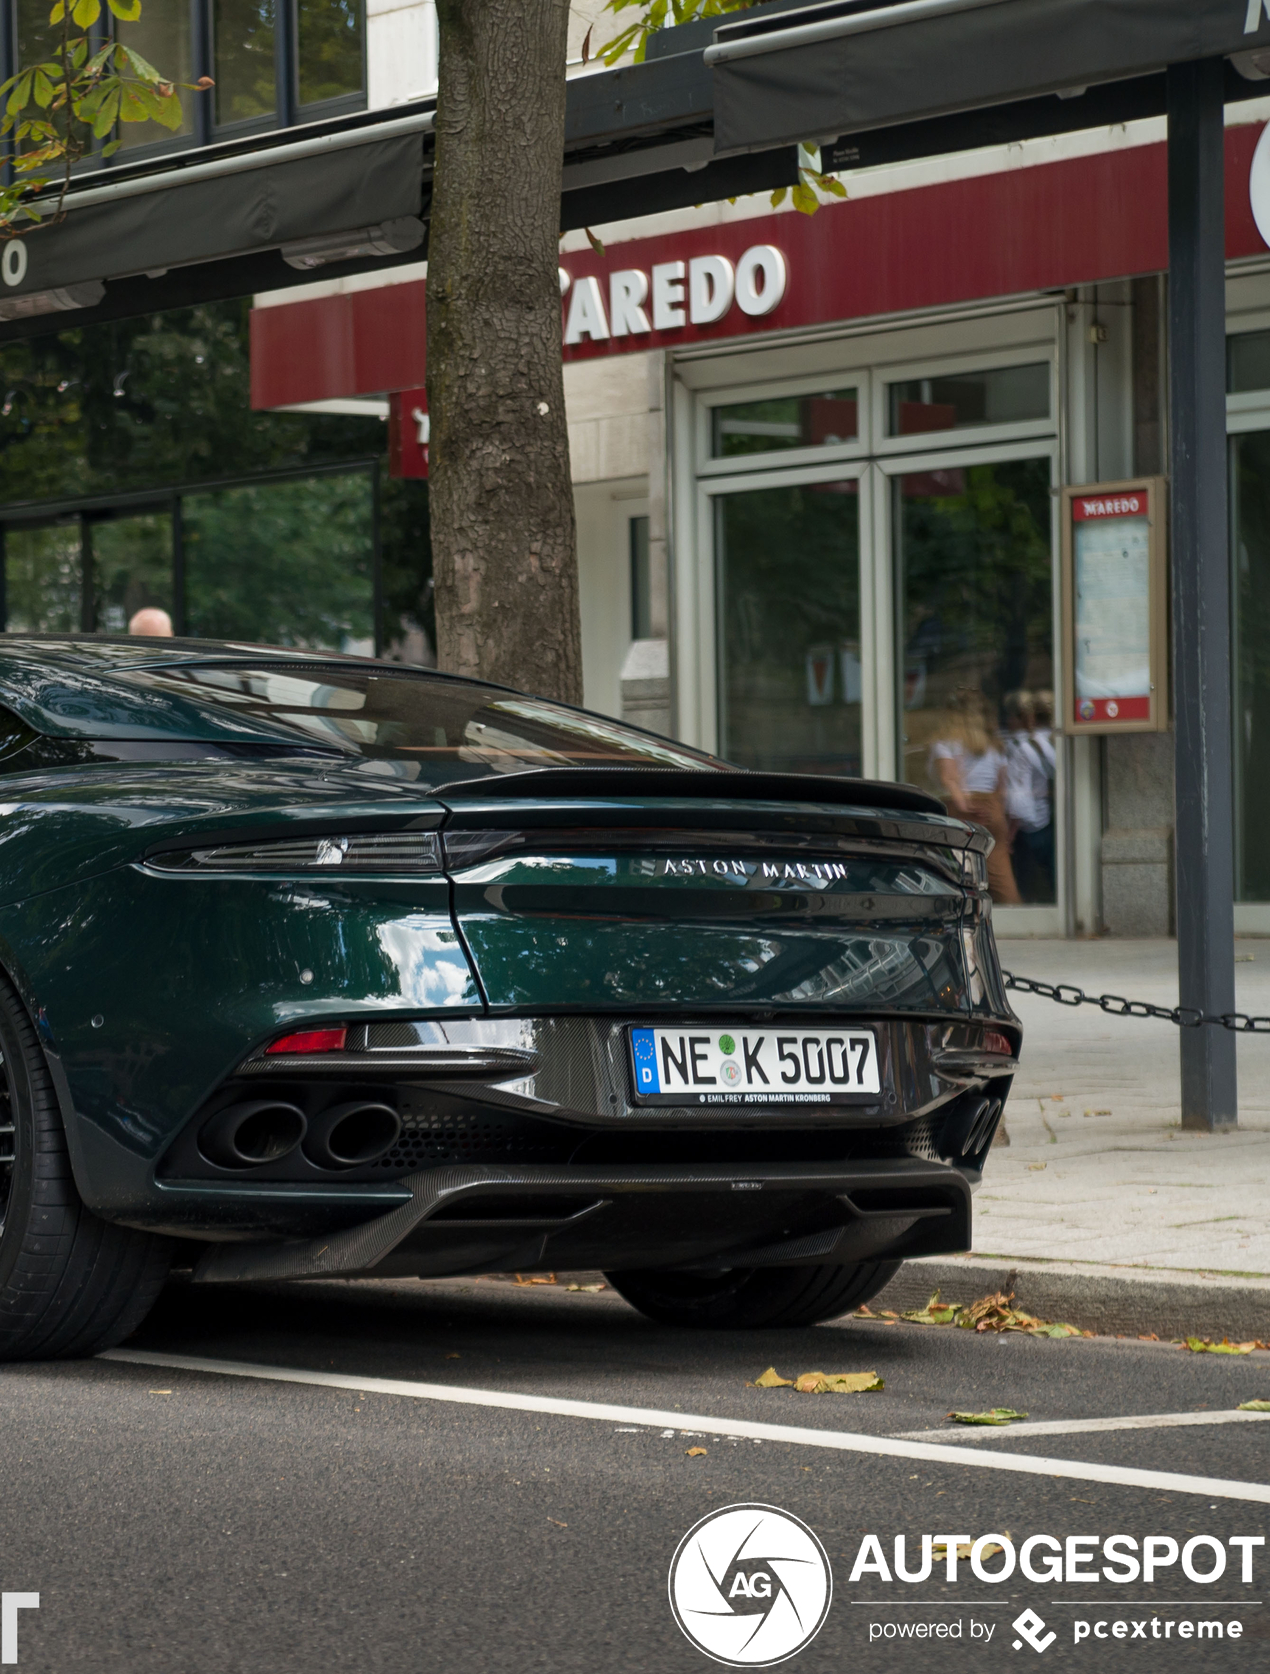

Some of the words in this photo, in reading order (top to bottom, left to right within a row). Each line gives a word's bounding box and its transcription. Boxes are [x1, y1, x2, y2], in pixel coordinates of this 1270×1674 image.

[559, 244, 787, 345] AREDO
[1083, 497, 1139, 516] MAREDO
[664, 858, 747, 875] ASTON
[762, 862, 847, 880] MARTIN
[660, 1036, 717, 1085] NE
[742, 1036, 770, 1085] K
[776, 1036, 870, 1085] 5007
[642, 1067, 653, 1083] D
[707, 1093, 725, 1103] EMIL
[725, 1093, 743, 1103] FREY
[744, 1093, 768, 1103] ASTON
[768, 1093, 795, 1103] MARTIN
[795, 1093, 831, 1103] KRONBERG
